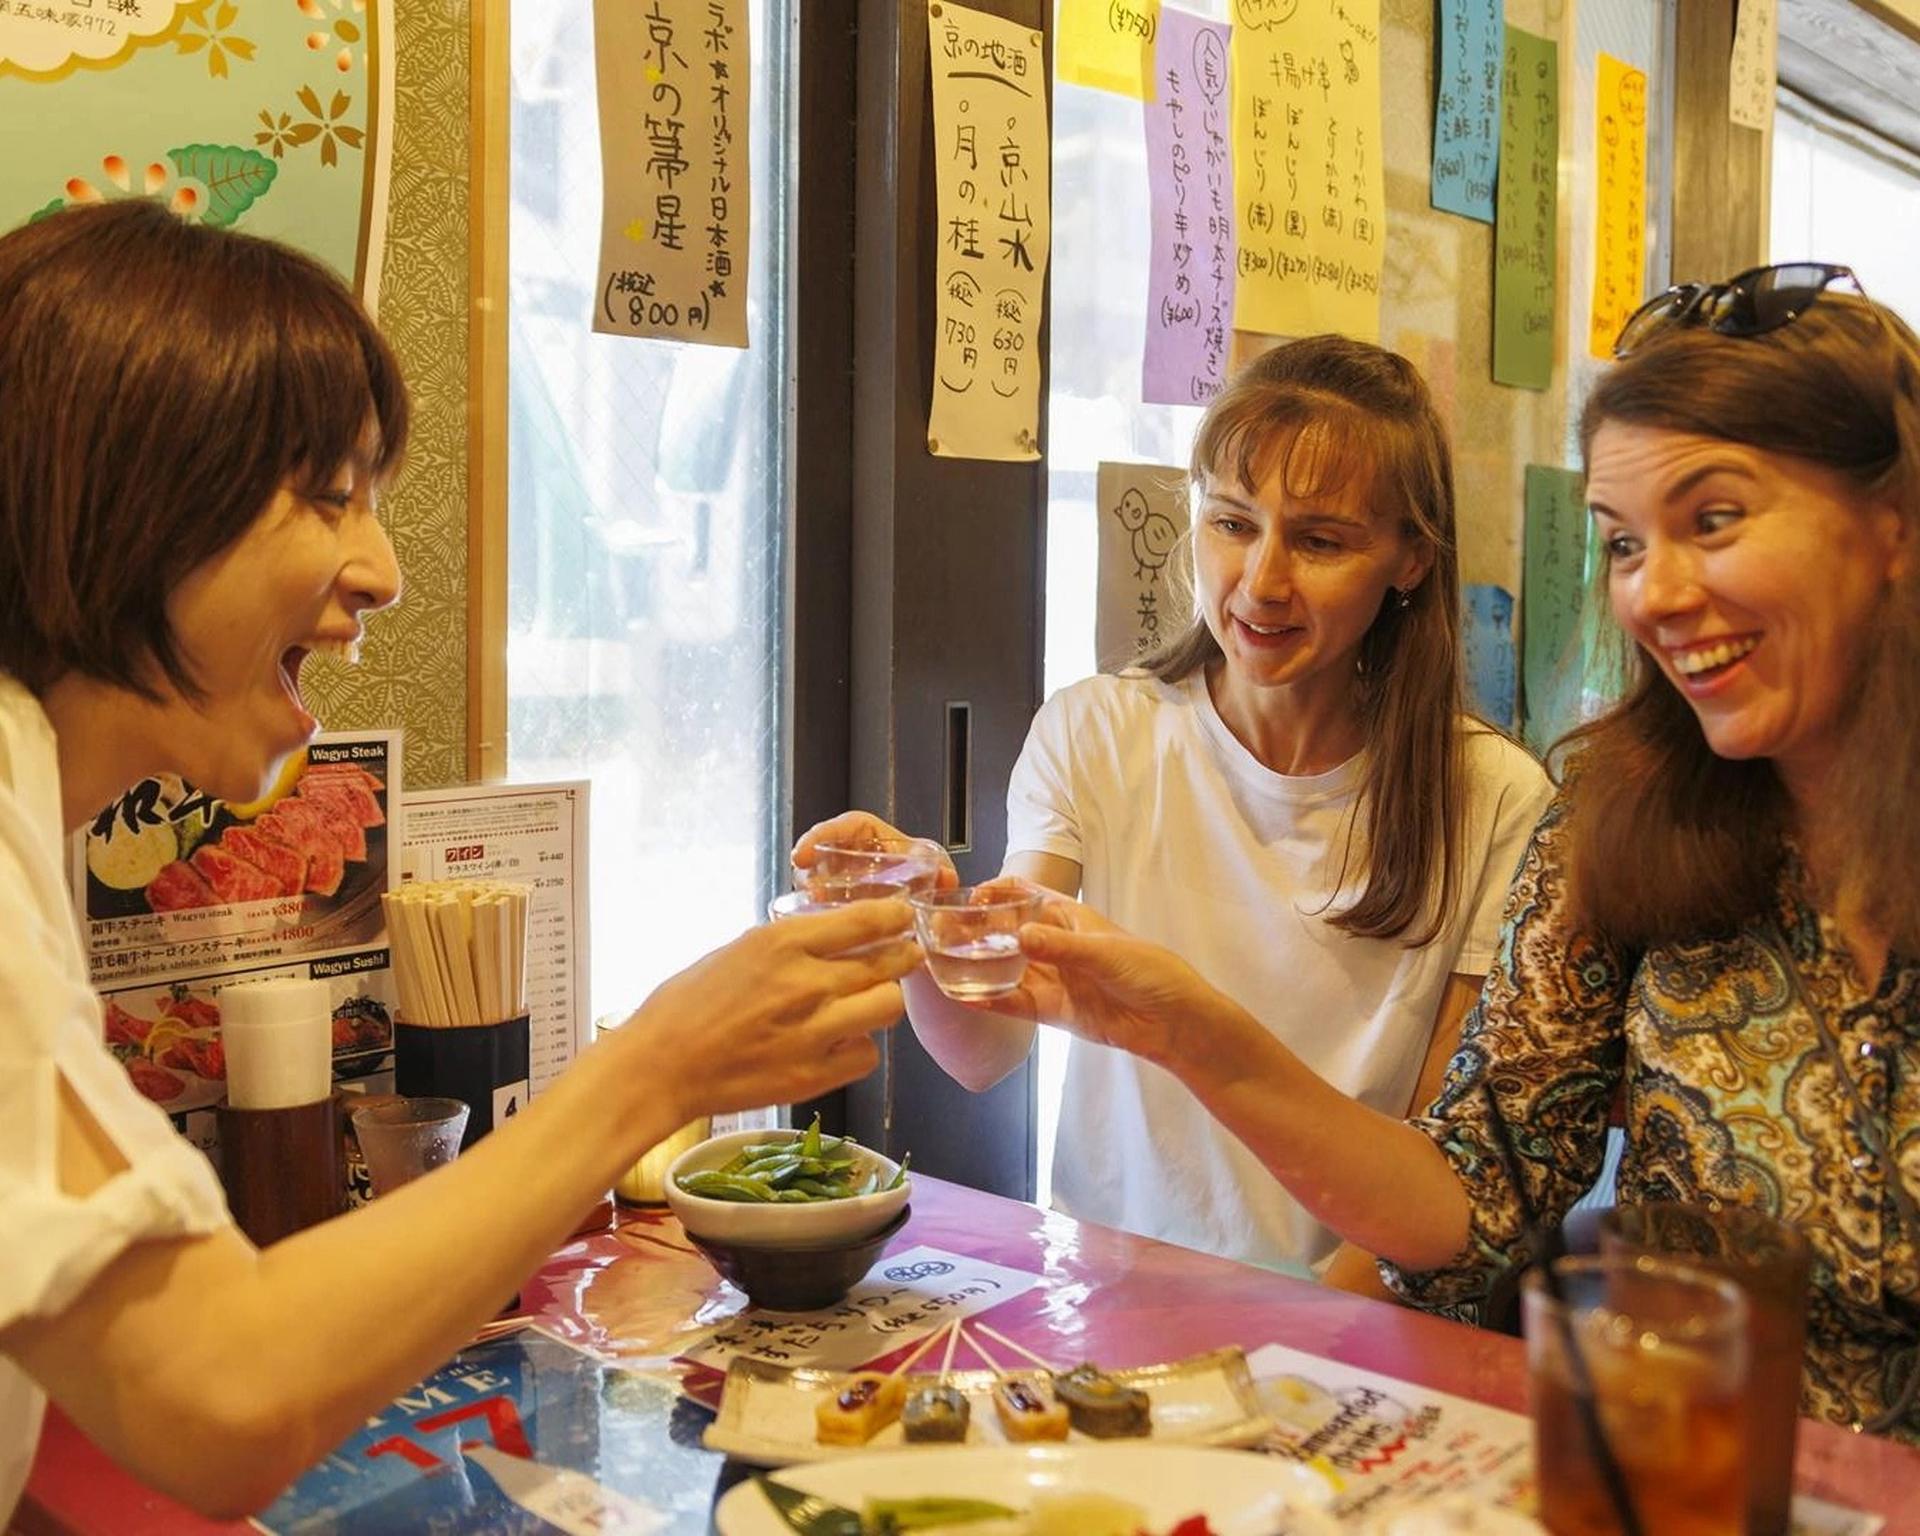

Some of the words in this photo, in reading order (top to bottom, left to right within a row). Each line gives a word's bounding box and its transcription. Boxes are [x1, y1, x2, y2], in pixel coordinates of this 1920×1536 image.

[943, 19, 1028, 76] 京の地酒
[312, 748, 349, 762] Wagyu
[351, 745, 385, 758] Steak
[446, 845, 484, 862] ワイン
[313, 960, 351, 975] Wagyu
[352, 953, 386, 969] Sushi
[504, 1095, 518, 1119] 4
